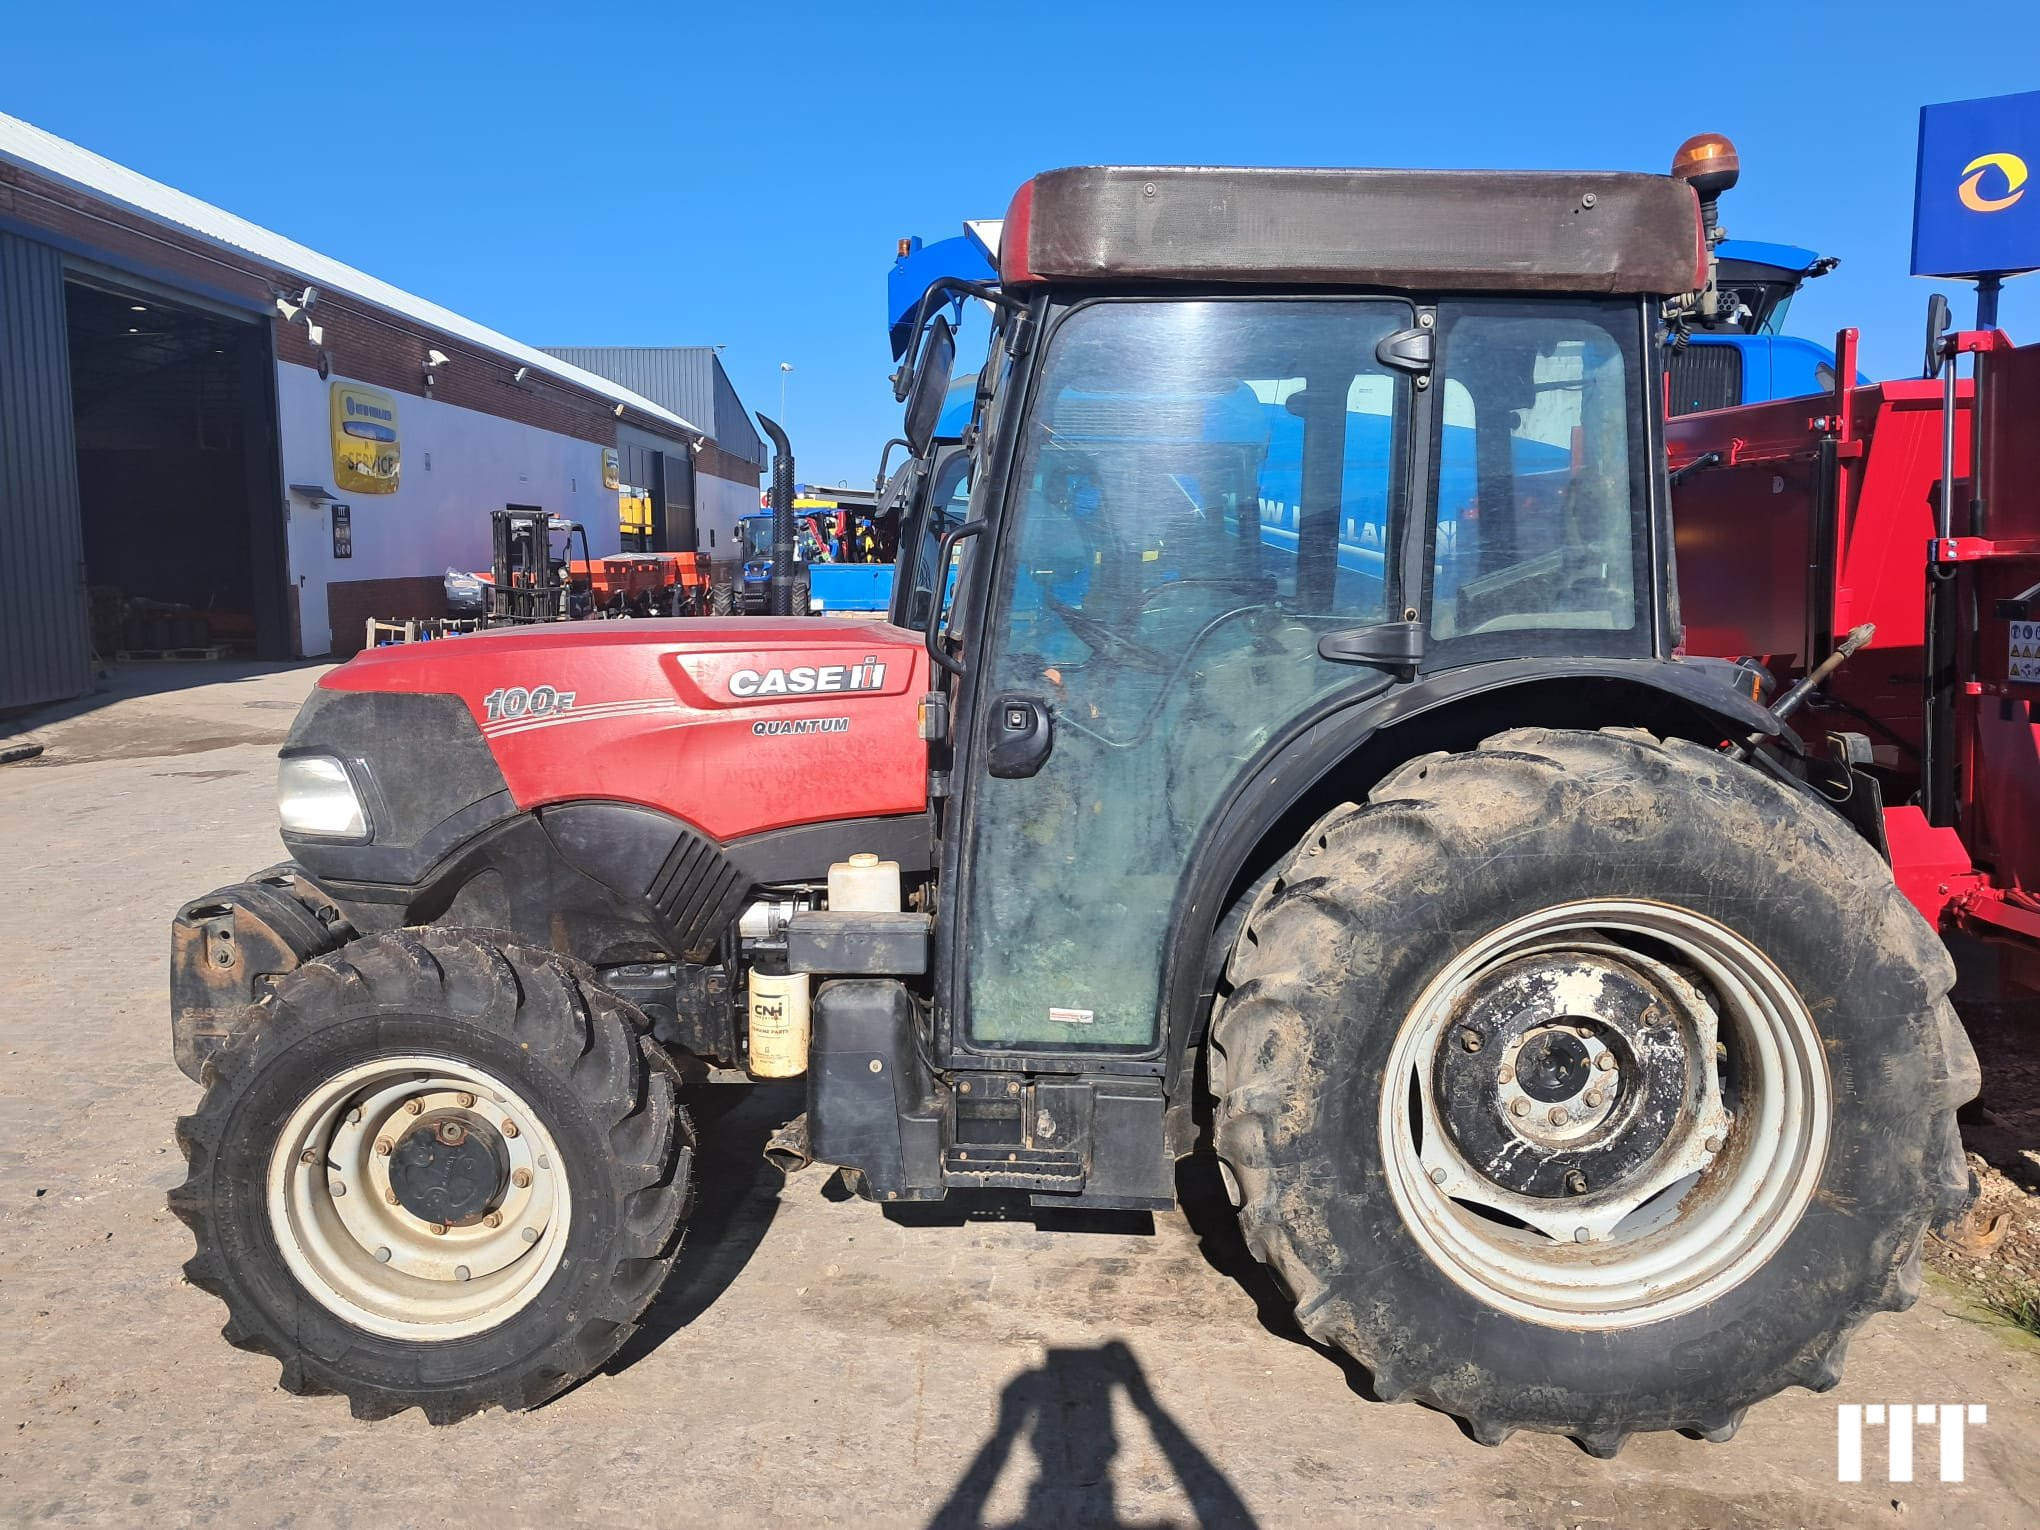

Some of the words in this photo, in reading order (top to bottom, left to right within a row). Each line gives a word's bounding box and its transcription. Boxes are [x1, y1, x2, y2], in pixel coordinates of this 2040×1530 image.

[729, 665, 846, 697] CASE
[484, 685, 576, 720] 100F
[752, 717, 849, 735] QUANTUM
